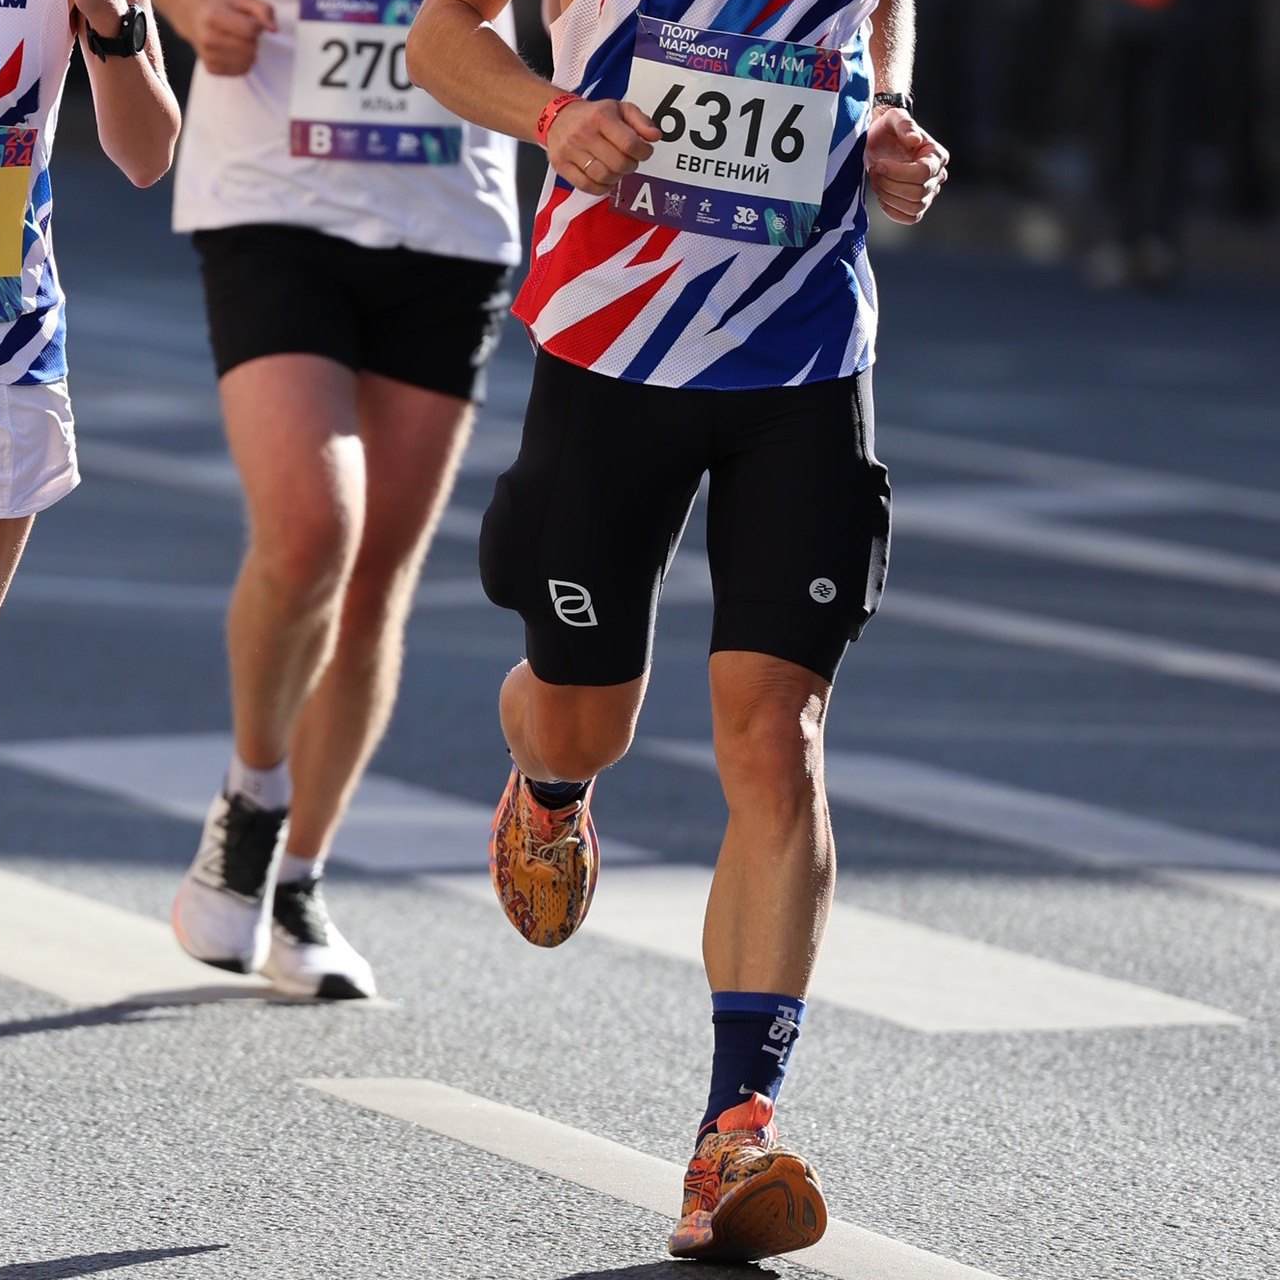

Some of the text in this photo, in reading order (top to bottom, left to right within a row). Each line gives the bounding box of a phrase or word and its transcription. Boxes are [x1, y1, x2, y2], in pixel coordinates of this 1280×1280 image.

[661, 24, 699, 41] ПОЛУ
[659, 36, 729, 60] МАРАФОН
[814, 47, 842, 71] 20
[748, 51, 805, 73] 21,1 КМ
[811, 68, 839, 92] 24
[651, 83, 805, 164] 6316
[5, 126, 38, 147] 20
[4, 147, 32, 167] 24
[675, 153, 770, 185] ЕВГЕНИЙ
